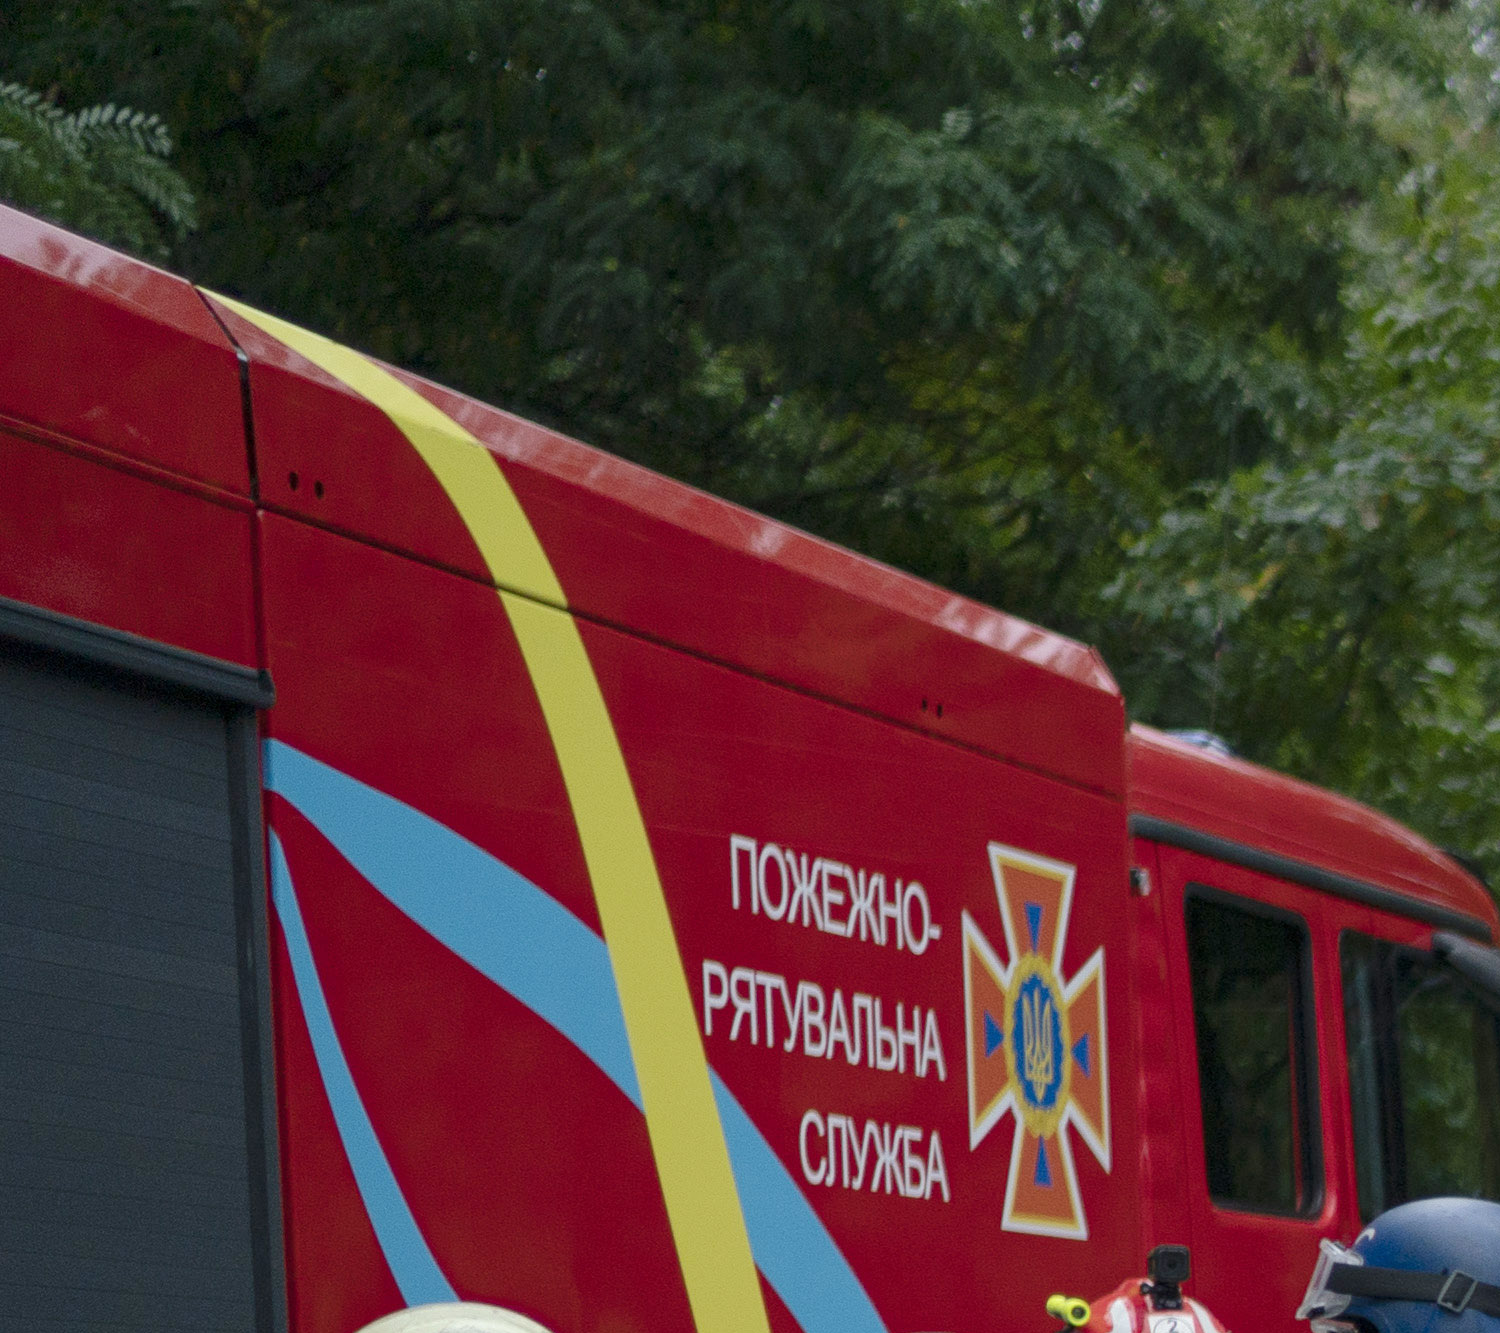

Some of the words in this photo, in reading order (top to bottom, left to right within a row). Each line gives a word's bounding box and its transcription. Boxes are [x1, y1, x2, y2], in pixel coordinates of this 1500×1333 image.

[730, 834, 942, 956] ПОЖЕЖНО-
[702, 959, 947, 1082] РЯТУВАЛЬНА
[799, 1109, 950, 1203] СЛУЖБА
